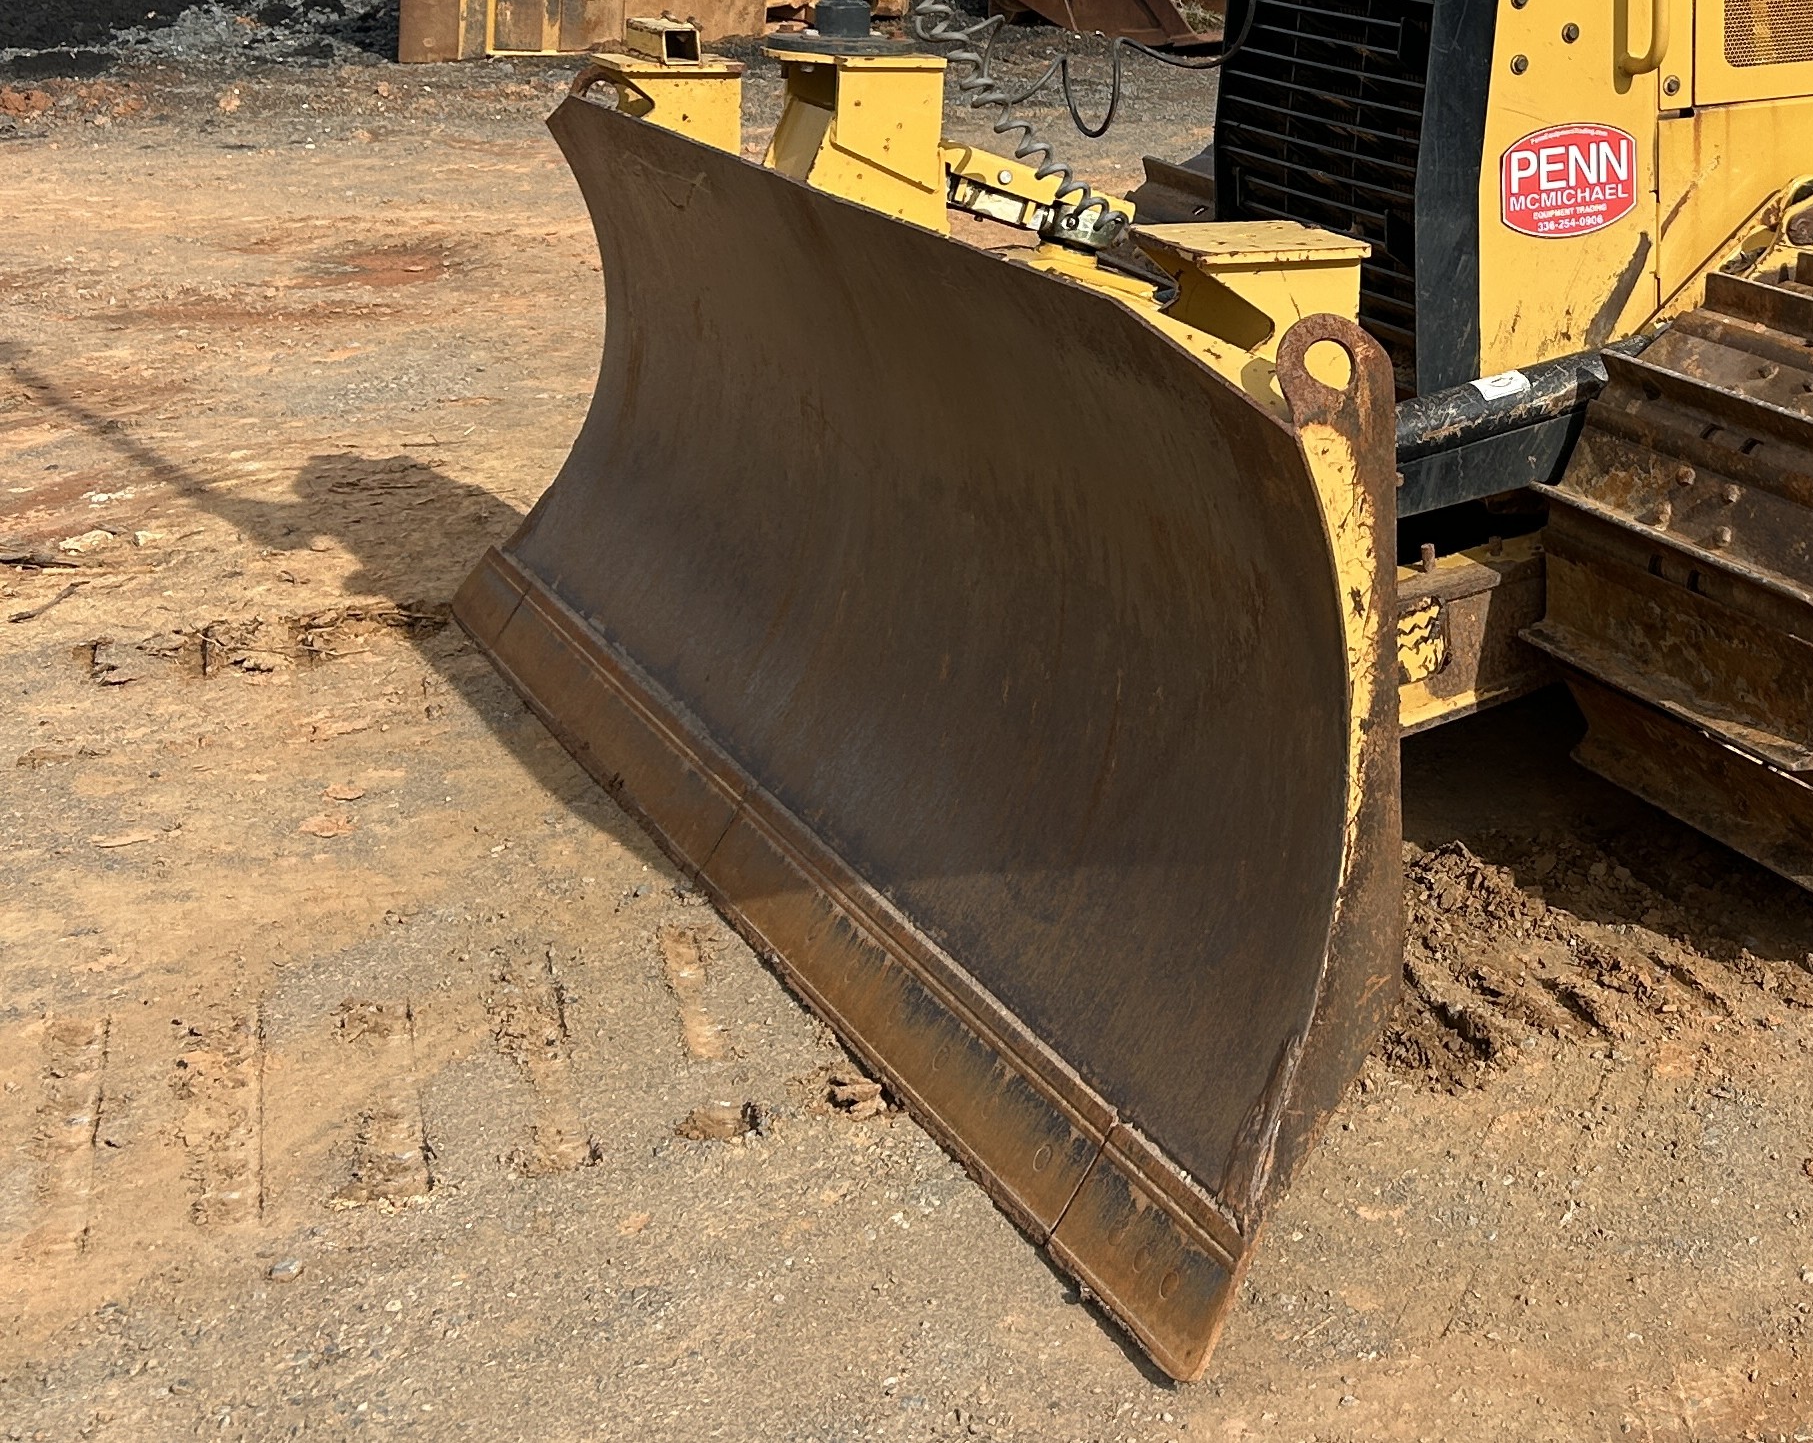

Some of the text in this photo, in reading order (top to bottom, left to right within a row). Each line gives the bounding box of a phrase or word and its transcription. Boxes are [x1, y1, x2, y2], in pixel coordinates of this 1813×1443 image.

[1509, 139, 1629, 194] PENN
[1509, 184, 1629, 212] MCMICHAEL
[1532, 203, 1608, 220] EQUIPMENT TRADING
